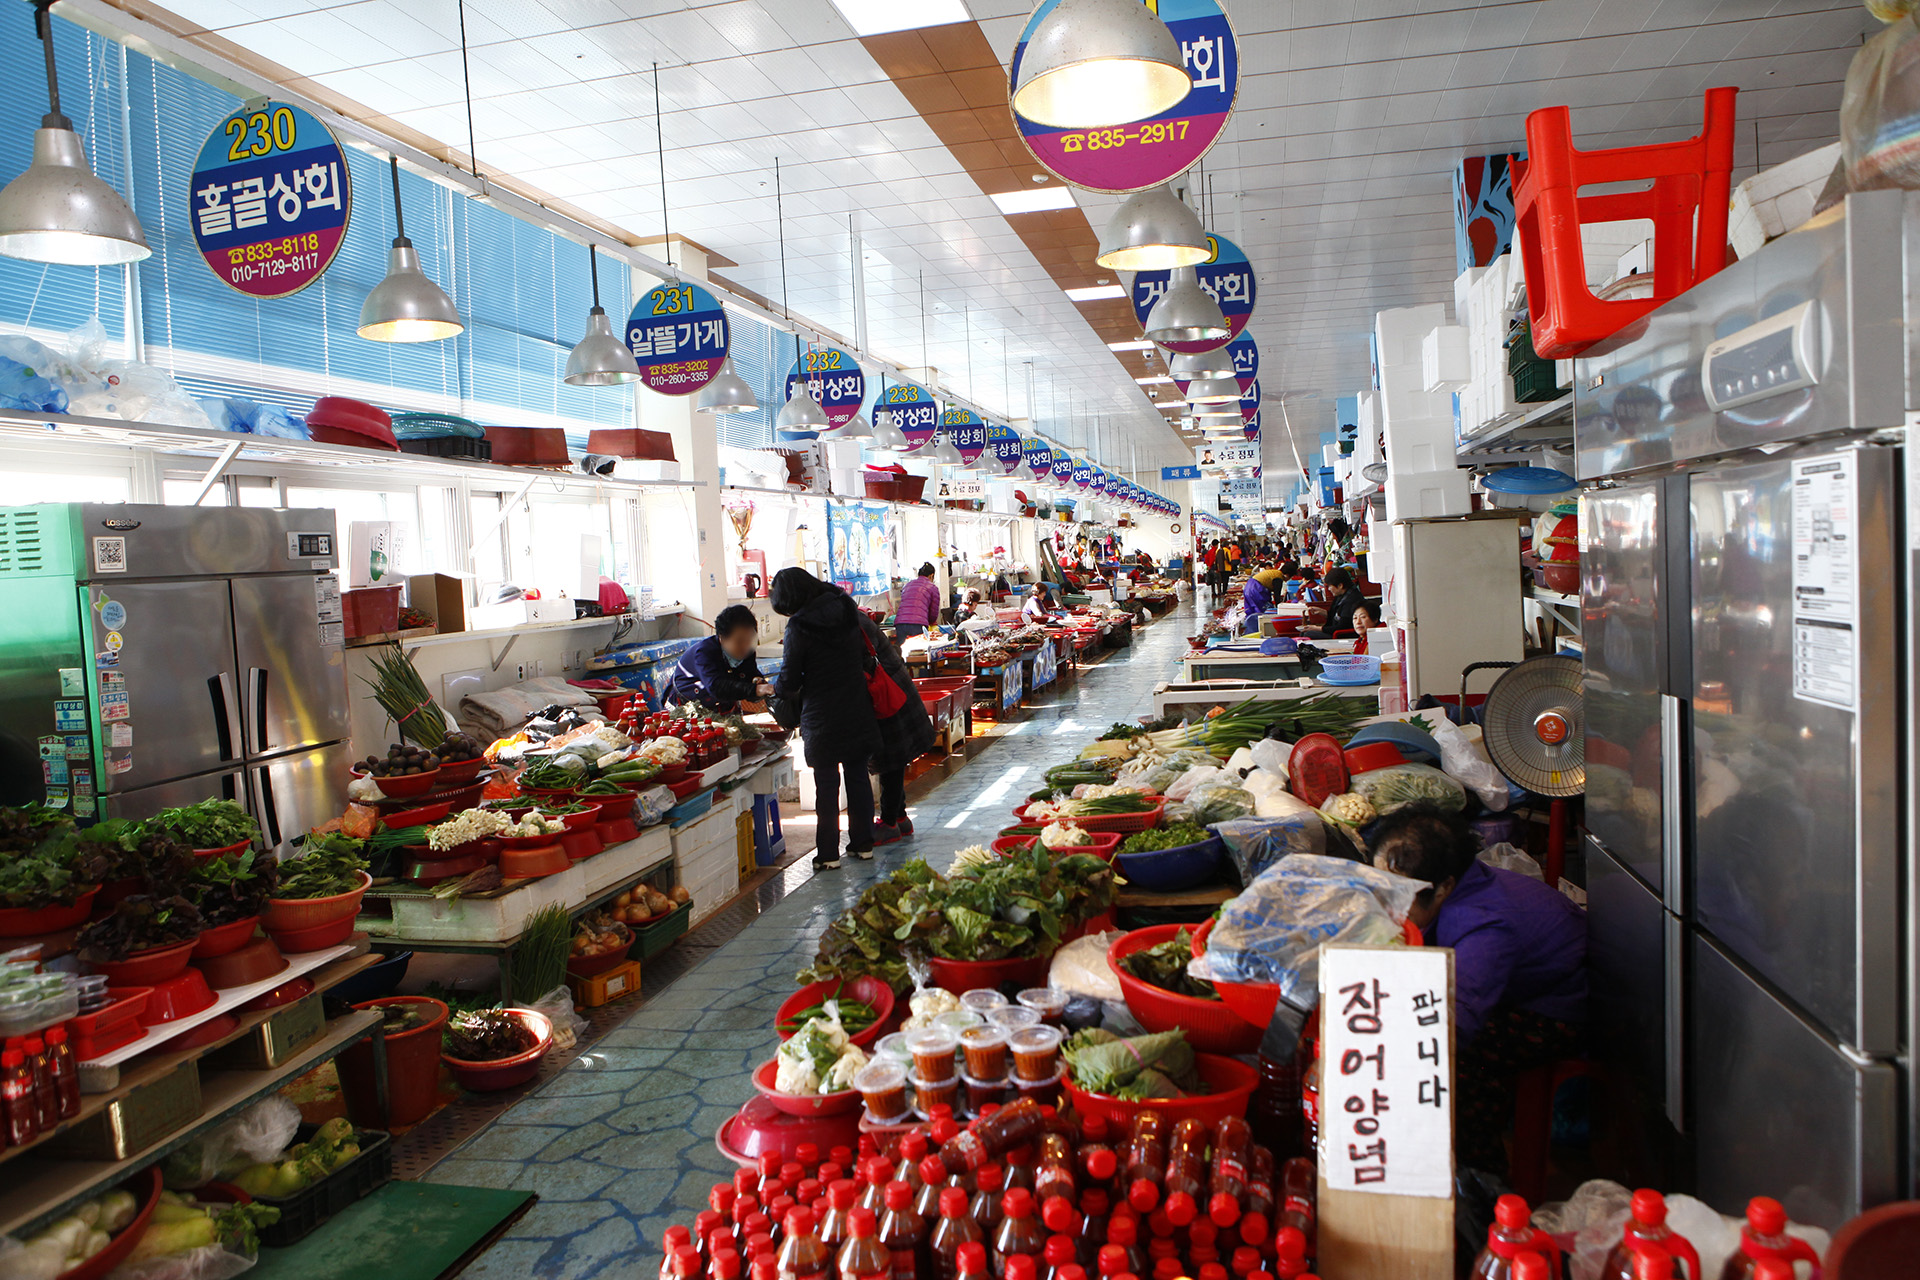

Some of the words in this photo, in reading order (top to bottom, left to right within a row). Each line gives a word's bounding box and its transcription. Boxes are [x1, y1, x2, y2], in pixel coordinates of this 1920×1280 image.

[1181, 36, 1225, 93] 회
[225, 107, 297, 162] 230
[1087, 121, 1190, 151] 835-2917
[197, 161, 342, 236] 홀골상회
[246, 234, 319, 262] 833-8118
[231, 253, 319, 283] 010-7129-8117
[651, 286, 694, 315] 231
[629, 319, 725, 358] 알뜰가게
[661, 360, 709, 375] 835-3202
[806, 350, 841, 372] 232
[789, 376, 862, 401] 명상회
[889, 386, 919, 403] 233
[875, 407, 935, 429] 성상회
[944, 410, 970, 425] 236
[988, 428, 1007, 438] 234
[1051, 449, 1062, 459] 35
[1411, 989, 1448, 1108] 팝니다
[1339, 978, 1390, 1185] 장어양념
